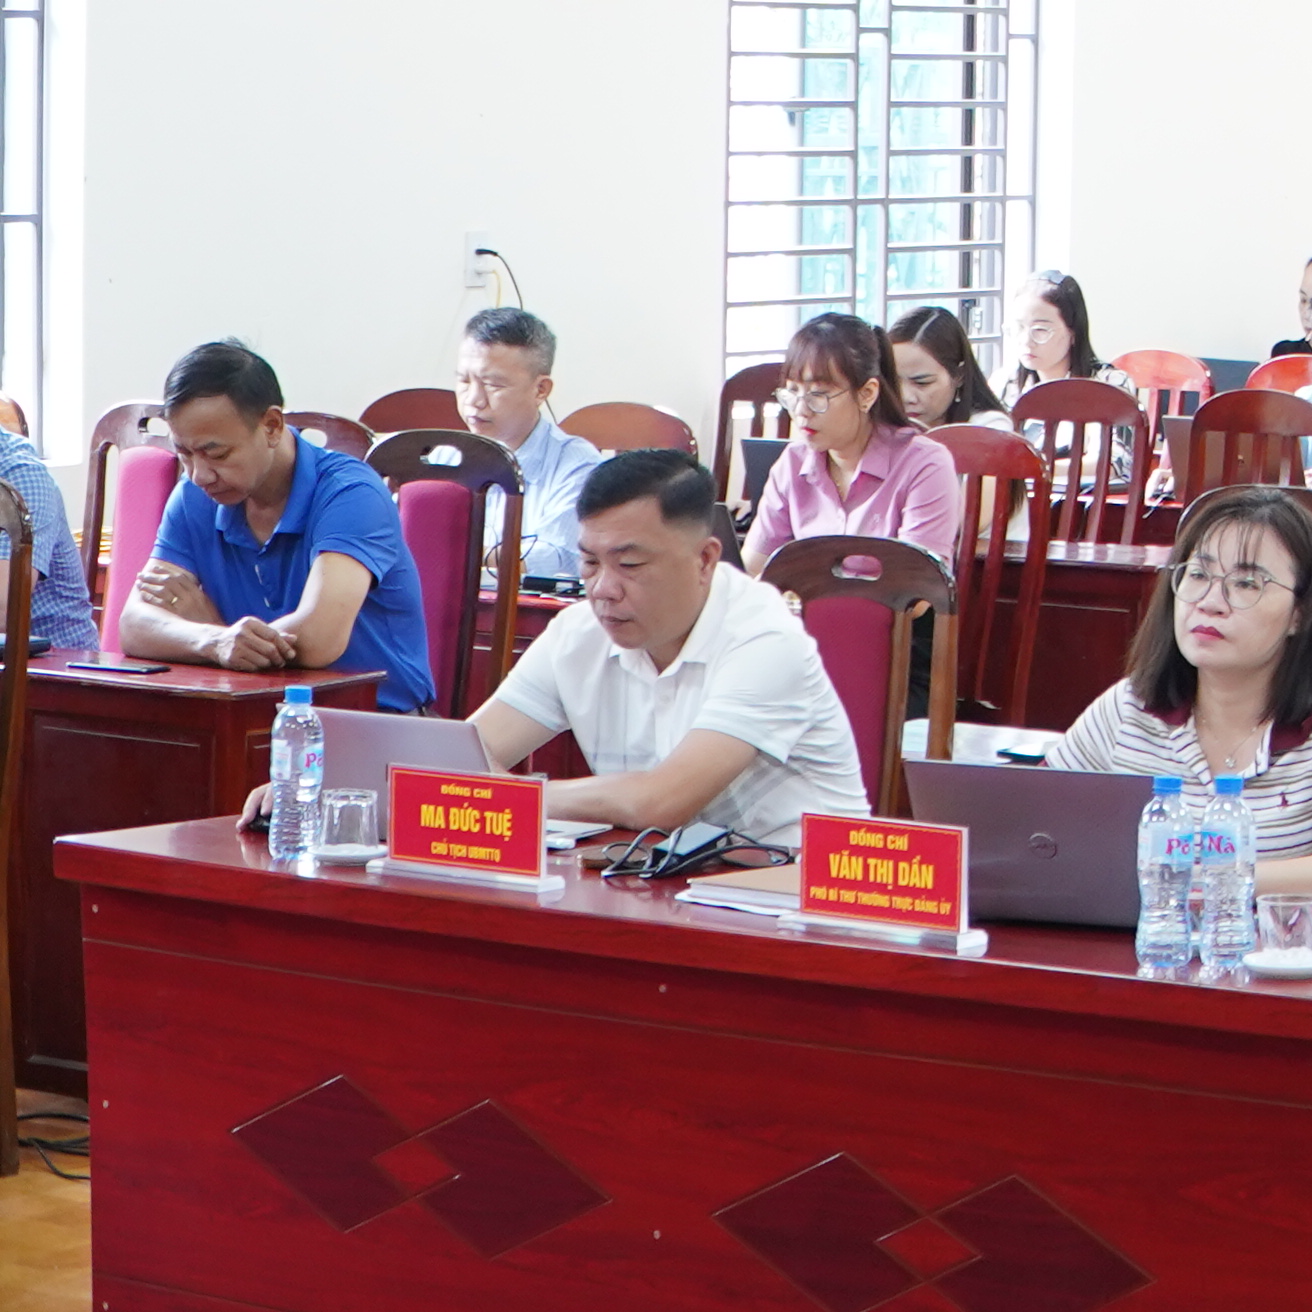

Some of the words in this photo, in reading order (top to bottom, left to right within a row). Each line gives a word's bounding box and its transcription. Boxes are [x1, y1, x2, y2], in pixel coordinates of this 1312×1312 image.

[420, 804, 446, 829] MA
[449, 802, 481, 833] ĐỨC
[867, 857, 894, 890] THỊ
